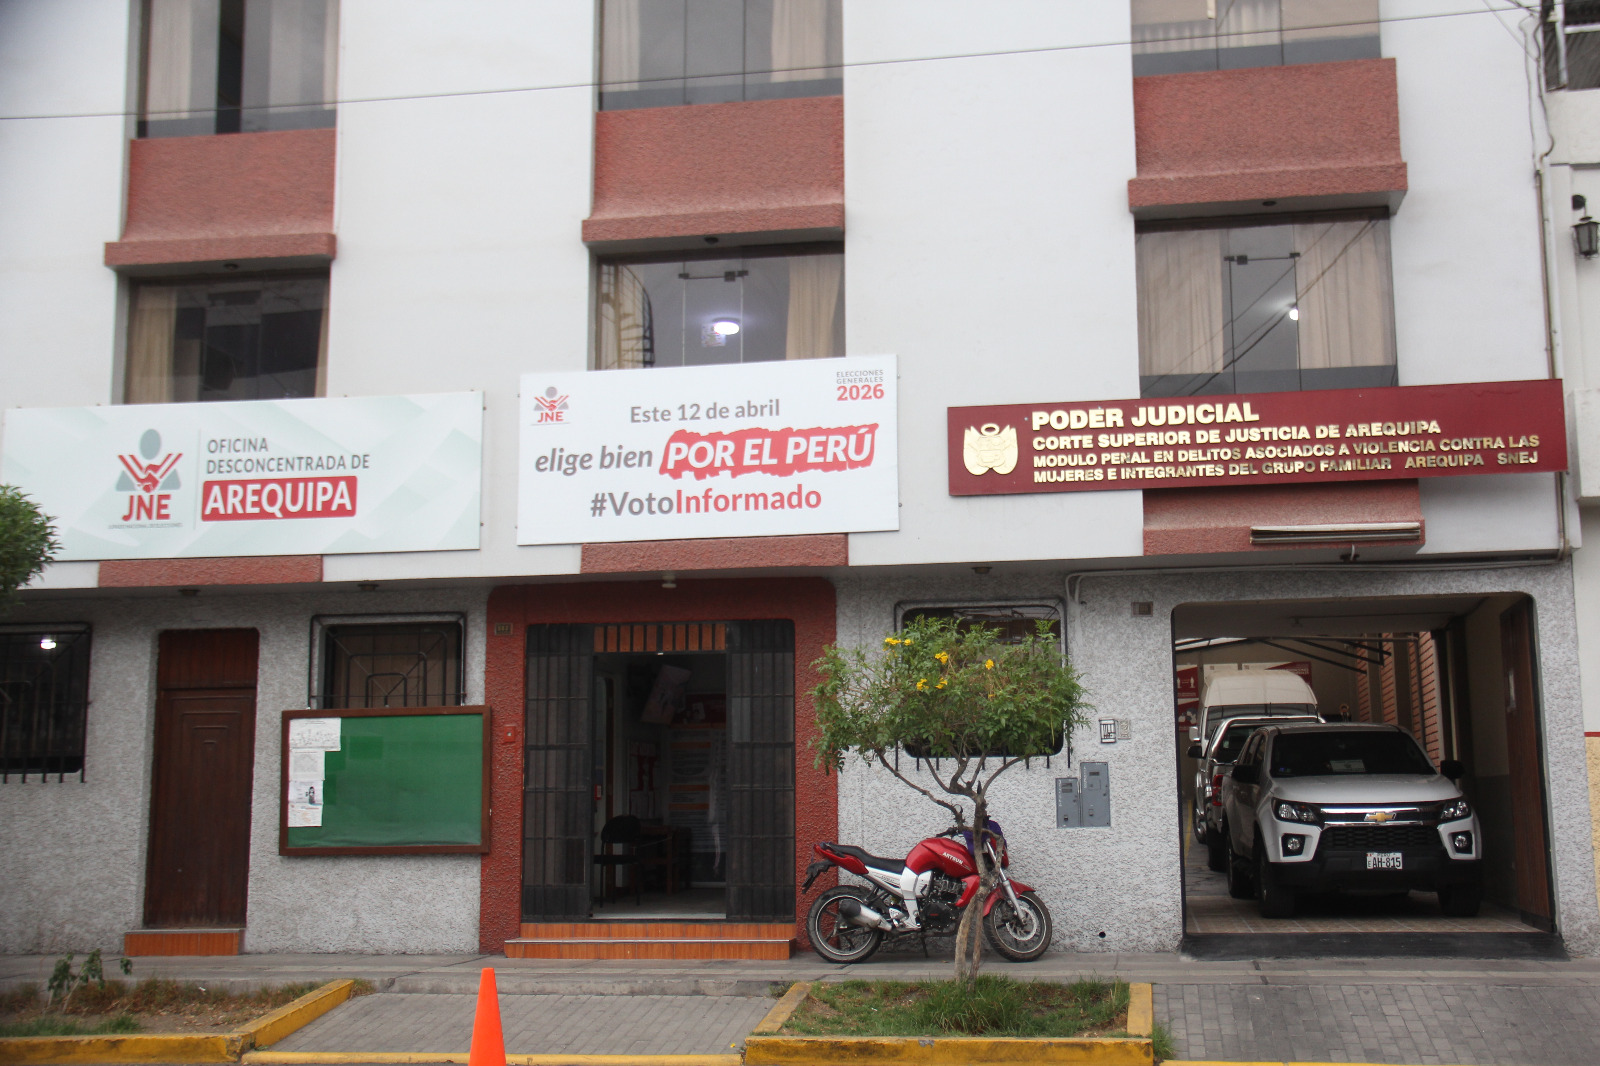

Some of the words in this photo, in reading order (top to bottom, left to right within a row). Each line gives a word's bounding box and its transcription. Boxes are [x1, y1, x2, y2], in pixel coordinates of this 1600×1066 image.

[836, 370, 884, 378] ELECCIONES
[836, 376, 884, 384] GENERALES
[836, 383, 885, 401] 2026
[537, 411, 564, 423] JNE
[630, 405, 672, 423] Este
[677, 403, 701, 421] 12
[705, 402, 730, 419] de
[734, 399, 780, 418] abril
[1032, 408, 1125, 431] PODER
[1131, 402, 1260, 427] JUDICIAL
[207, 438, 269, 454] OFICINA
[1032, 435, 1094, 451] CORTE
[1098, 431, 1191, 448] SUPERIOR
[1195, 430, 1221, 444] DE
[1225, 426, 1311, 443] JUSTICIA
[1315, 424, 1341, 439] DE
[1345, 420, 1442, 437] AREQUIPA
[206, 455, 347, 474] DESCONCENTRADA
[351, 454, 371, 469] DE
[535, 447, 593, 476] elige
[599, 444, 653, 470] bien
[667, 440, 735, 469] POR
[743, 438, 778, 466] EL
[785, 427, 873, 464] PERÚ
[1033, 453, 1098, 468] MODULO
[1101, 451, 1150, 465] PENAL
[1153, 449, 1174, 463] EN
[1177, 447, 1242, 462] DELITOS
[1245, 443, 1335, 459] ASOCIADOS
[1338, 443, 1350, 456] A
[1352, 439, 1436, 455] VIOLENCIA
[1439, 436, 1506, 451] CONTRA
[1508, 435, 1540, 448] LAS
[1033, 468, 1104, 483] MUJERES
[1107, 467, 1118, 480] E
[1120, 463, 1225, 480] INTEGRANTES
[1228, 463, 1259, 476] DEL
[1261, 460, 1316, 474] GRUPO
[1320, 457, 1392, 472] FAMILIAR
[1404, 453, 1485, 469] AREQUIPA
[1497, 451, 1539, 465] SNEJ
[122, 494, 171, 521] JNE
[204, 481, 352, 518] AREQUIPA
[590, 483, 822, 517] #VotoInformado
